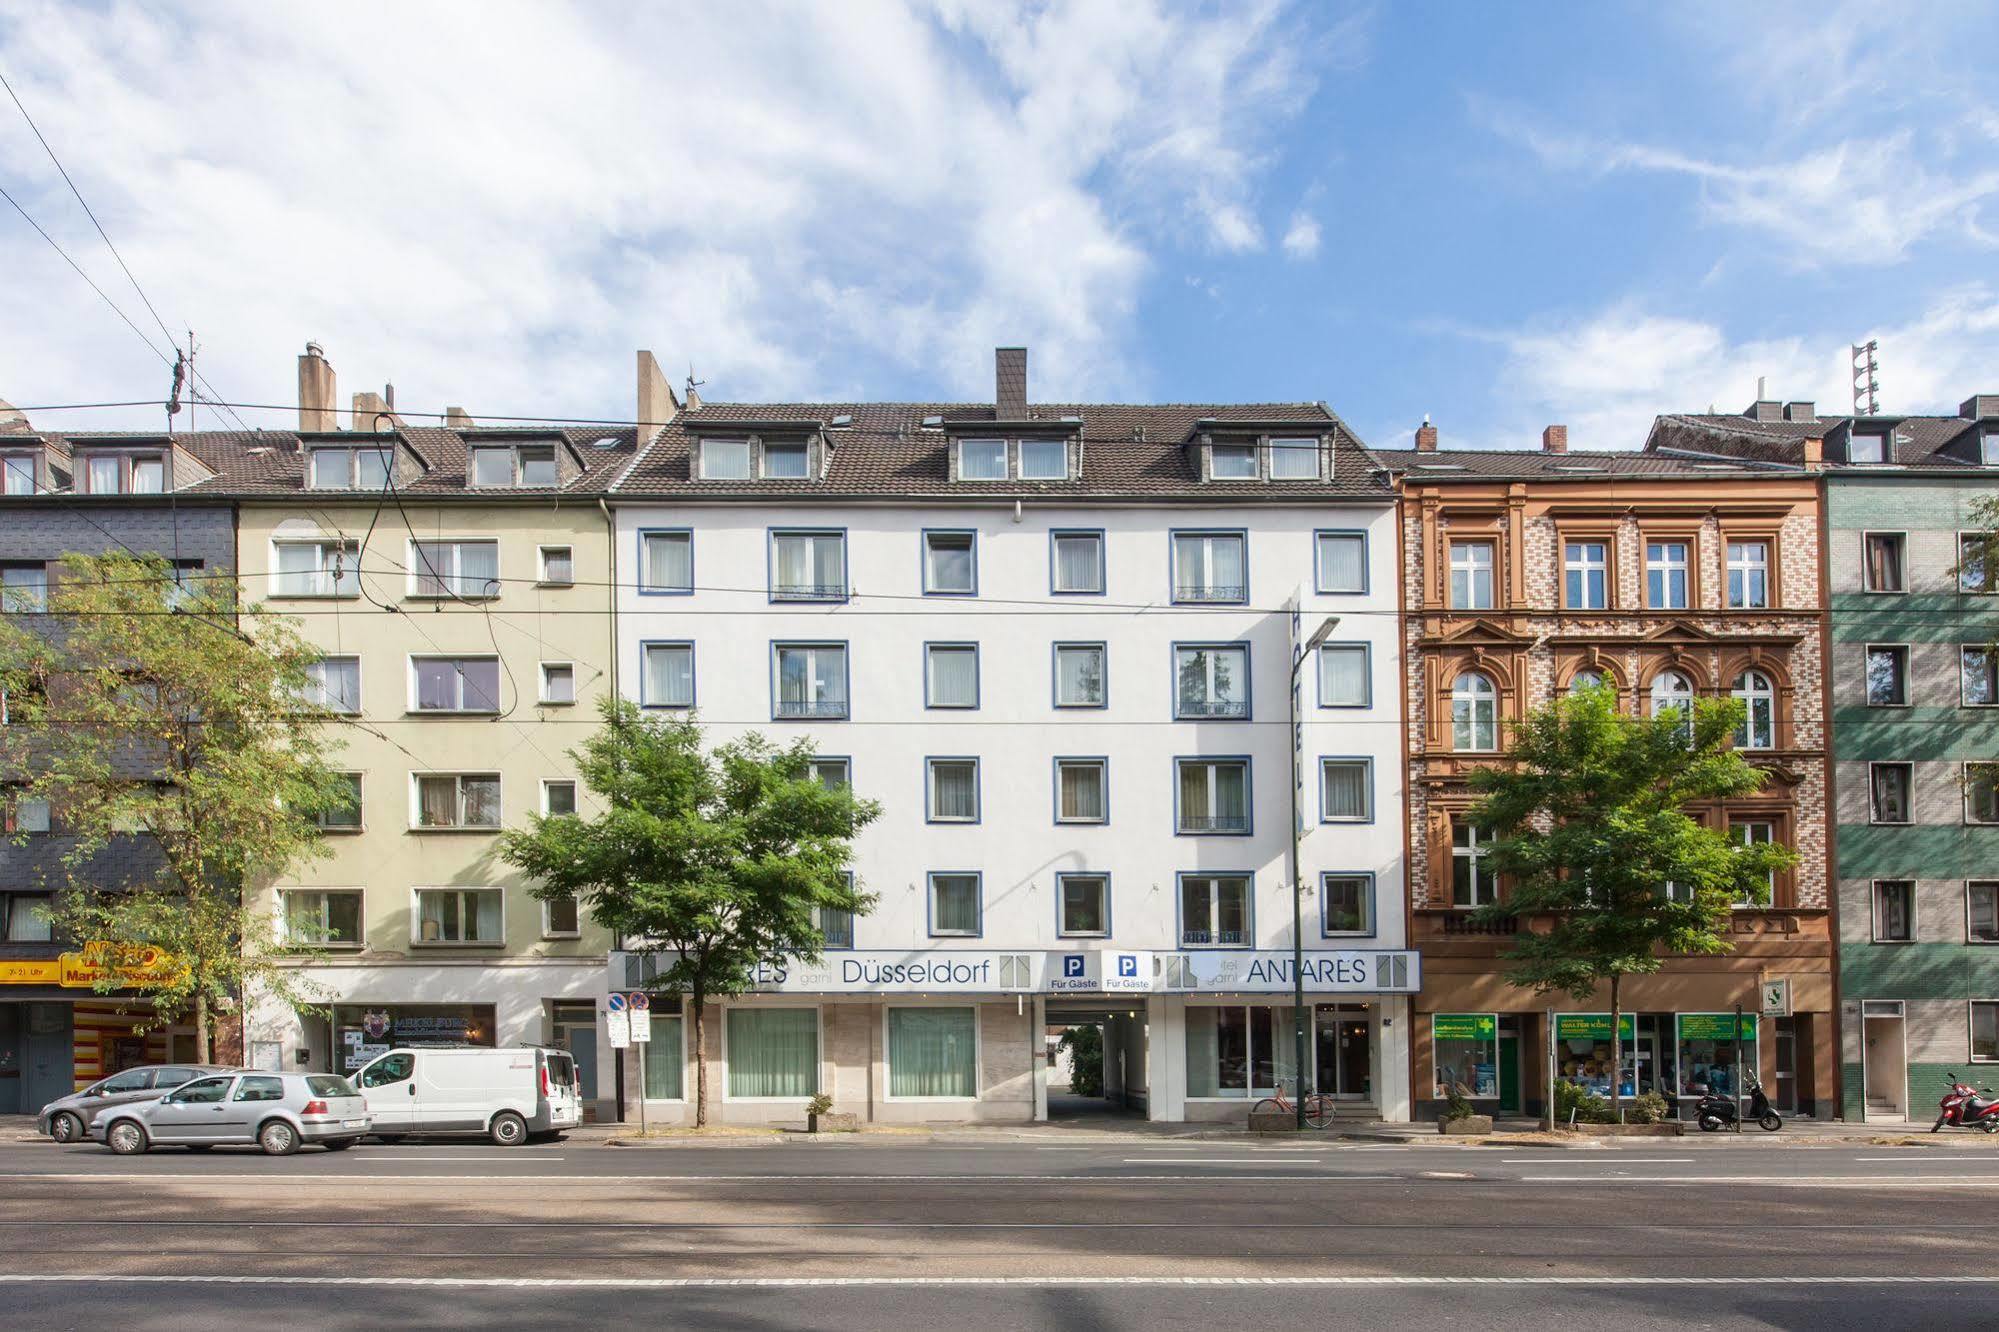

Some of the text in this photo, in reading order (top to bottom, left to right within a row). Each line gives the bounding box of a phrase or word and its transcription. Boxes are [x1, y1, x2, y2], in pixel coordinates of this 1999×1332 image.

[1292, 600, 1302, 789] HOTEL
[843, 959, 990, 983] Düsseldorf
[1068, 958, 1081, 975] P
[1122, 958, 1134, 975] P
[1247, 959, 1366, 983] ANTARES
[1051, 979, 1098, 989] Für Gäste
[1106, 979, 1149, 988] Für Gäste
